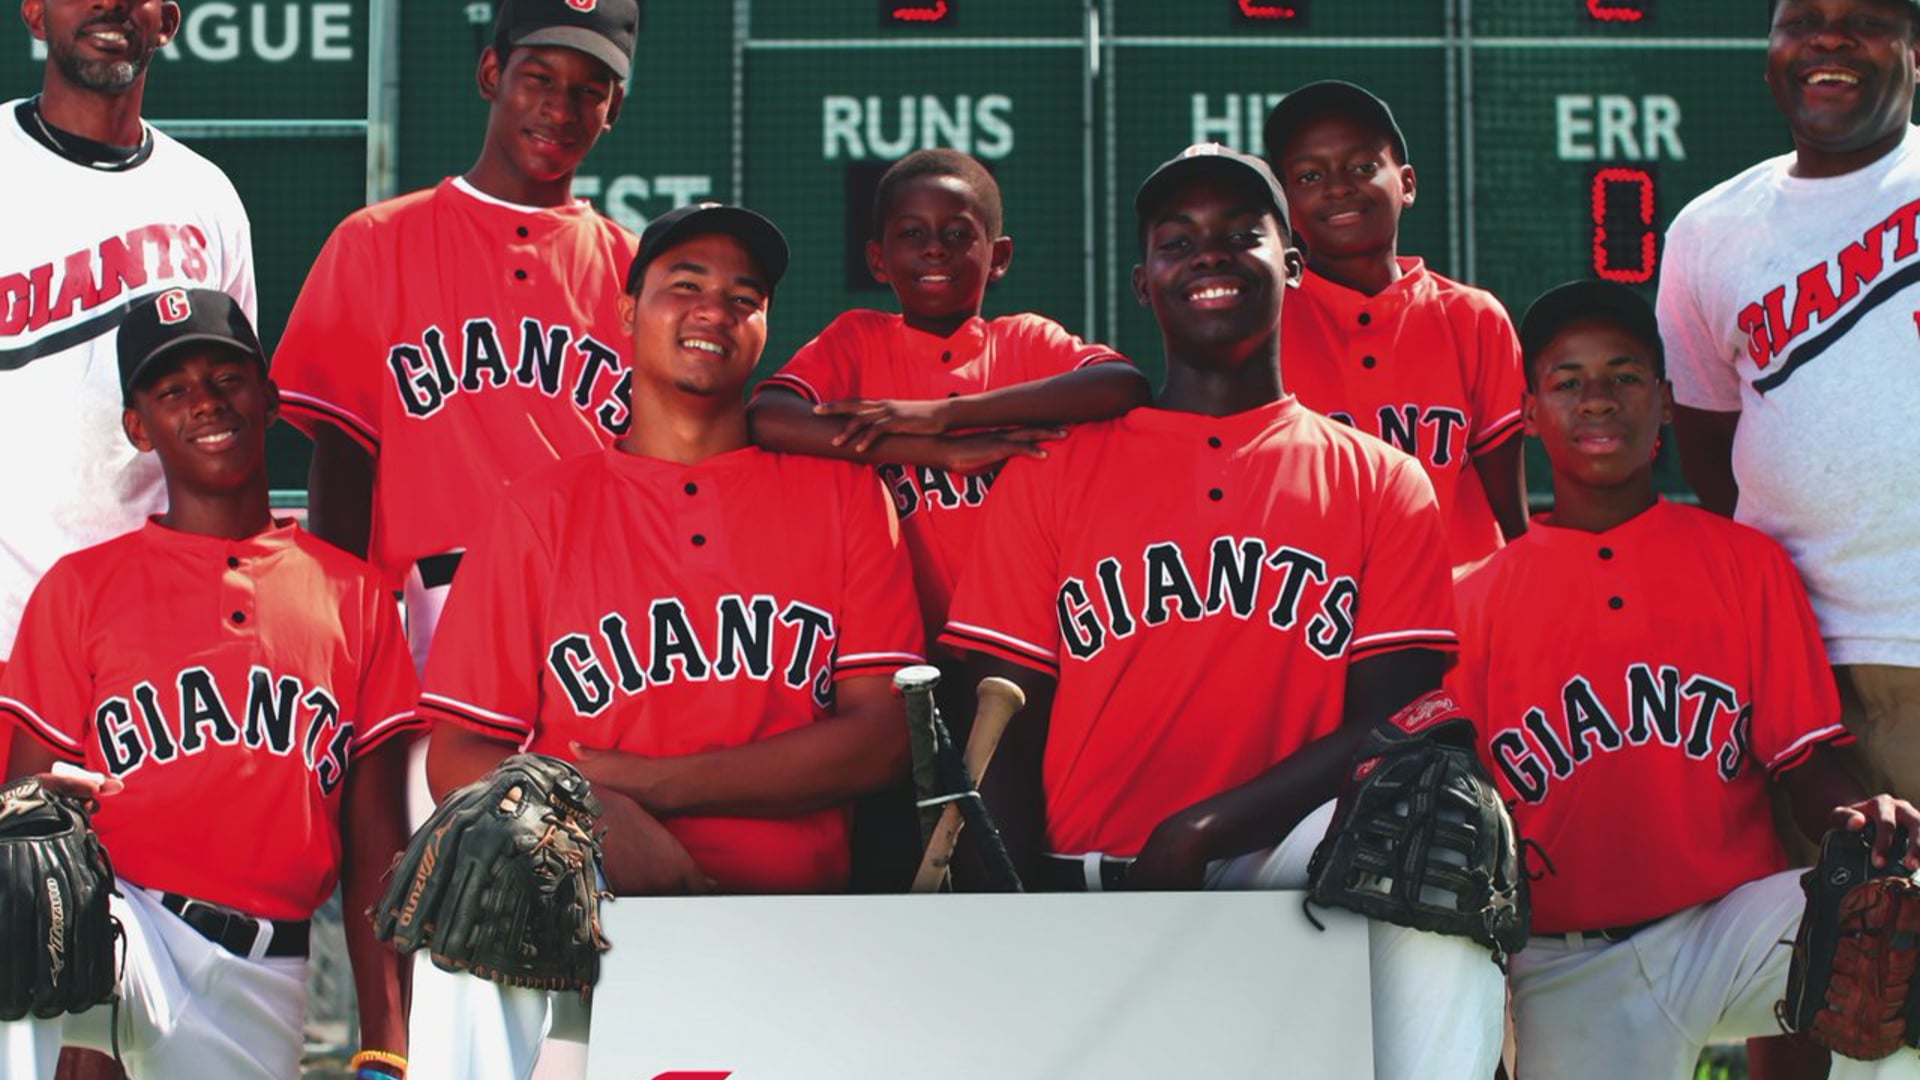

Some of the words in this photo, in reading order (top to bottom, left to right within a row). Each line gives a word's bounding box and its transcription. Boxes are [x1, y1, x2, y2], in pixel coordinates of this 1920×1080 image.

[31, 3, 353, 61] GUE
[823, 94, 1014, 158] RUNS
[1556, 95, 1686, 160] ERR
[1592, 168, 1655, 282] 0
[0, 223, 208, 336] GIANTS
[155, 289, 191, 324] G
[1056, 535, 1358, 660] GIANTS
